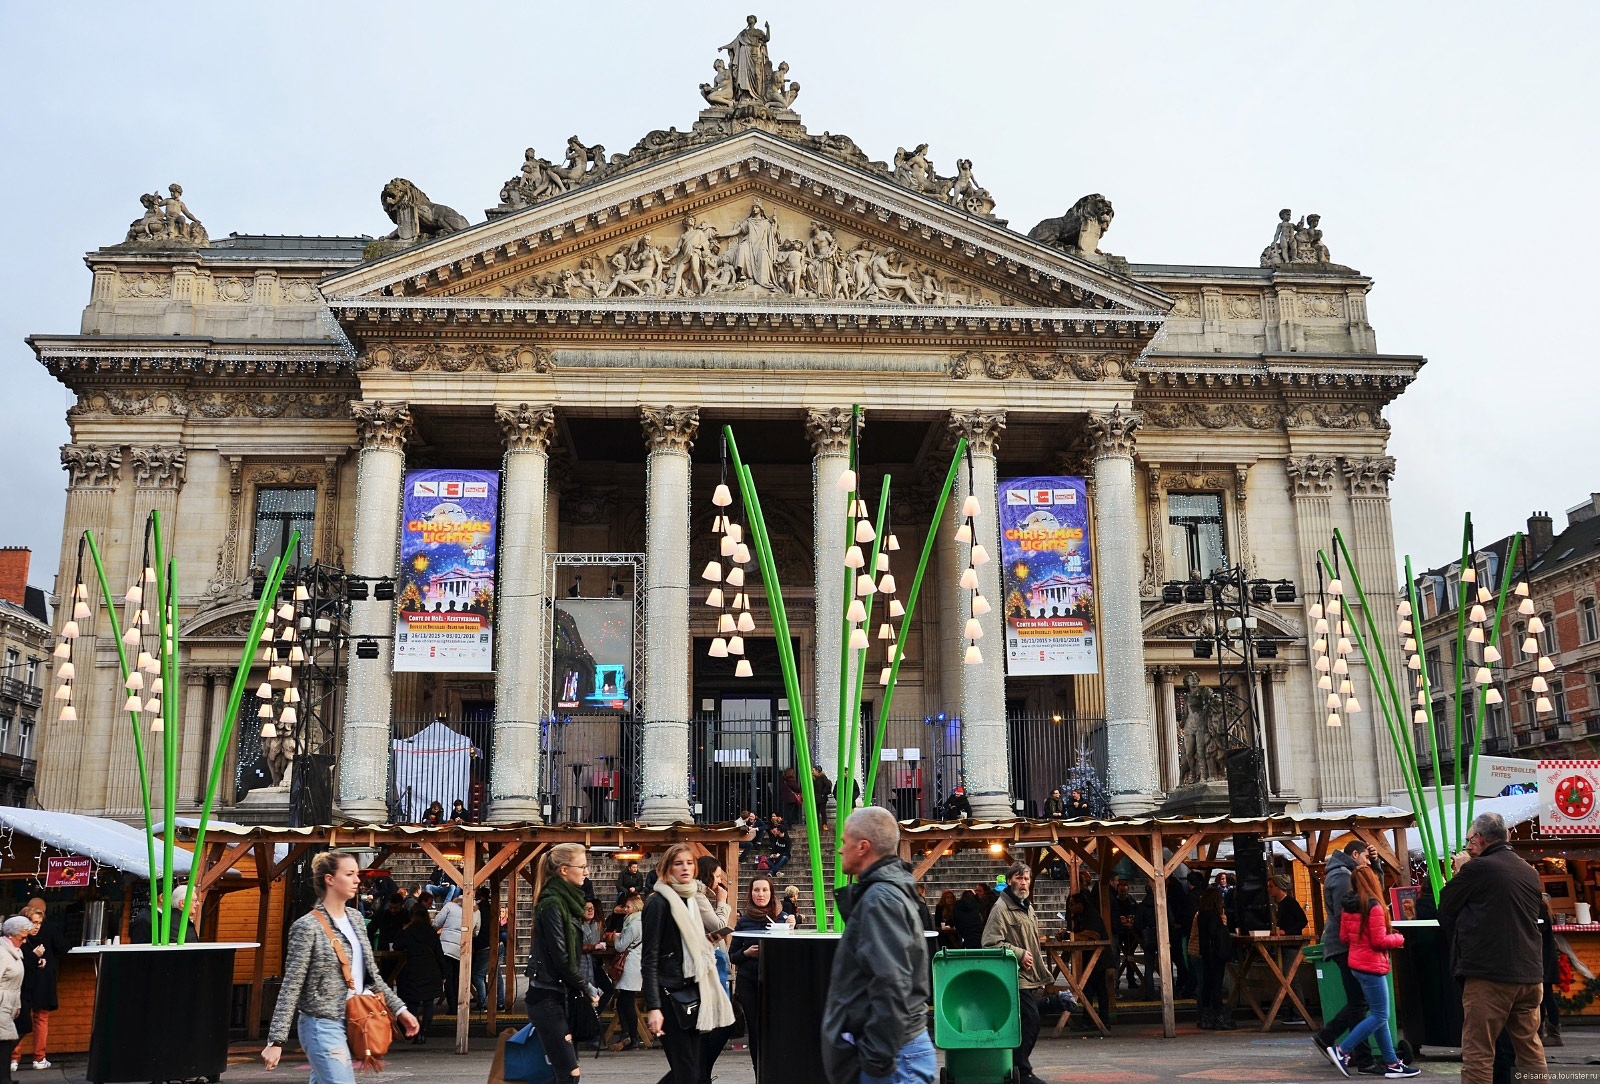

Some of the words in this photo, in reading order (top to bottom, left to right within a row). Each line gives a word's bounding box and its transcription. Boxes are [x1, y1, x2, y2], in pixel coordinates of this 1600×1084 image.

[407, 521, 491, 533] CHRISTMAS
[423, 532, 474, 544] LIGHTS
[1005, 528, 1083, 540] CHRISTMAS
[1020, 540, 1069, 551] LIGHTS
[471, 549, 486, 560] 3D
[1067, 555, 1082, 566] 3D
[1491, 765, 1536, 774] SMOUTEBOLLEN
